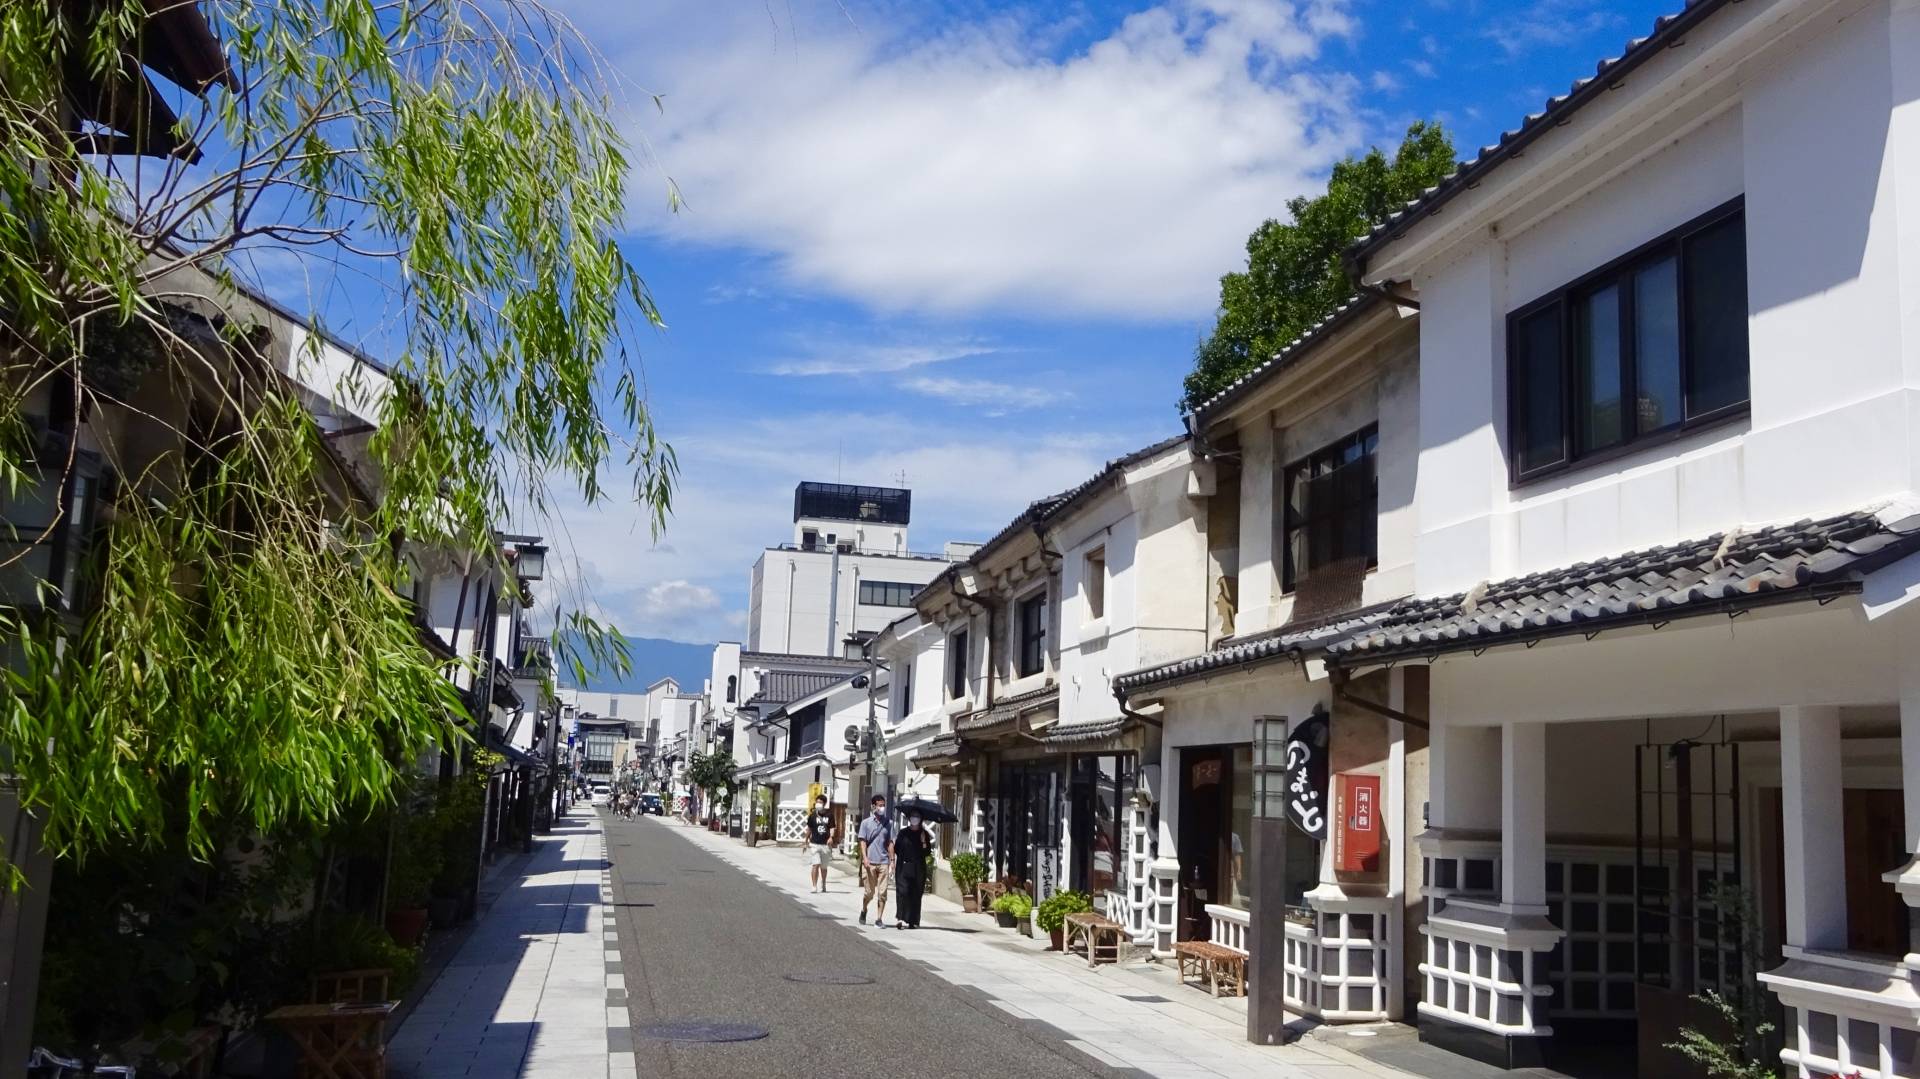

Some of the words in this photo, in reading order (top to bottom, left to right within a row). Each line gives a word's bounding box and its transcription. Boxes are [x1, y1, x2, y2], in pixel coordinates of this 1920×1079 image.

[1287, 740, 1323, 832] のまど
[1359, 792, 1368, 826] 消火器
